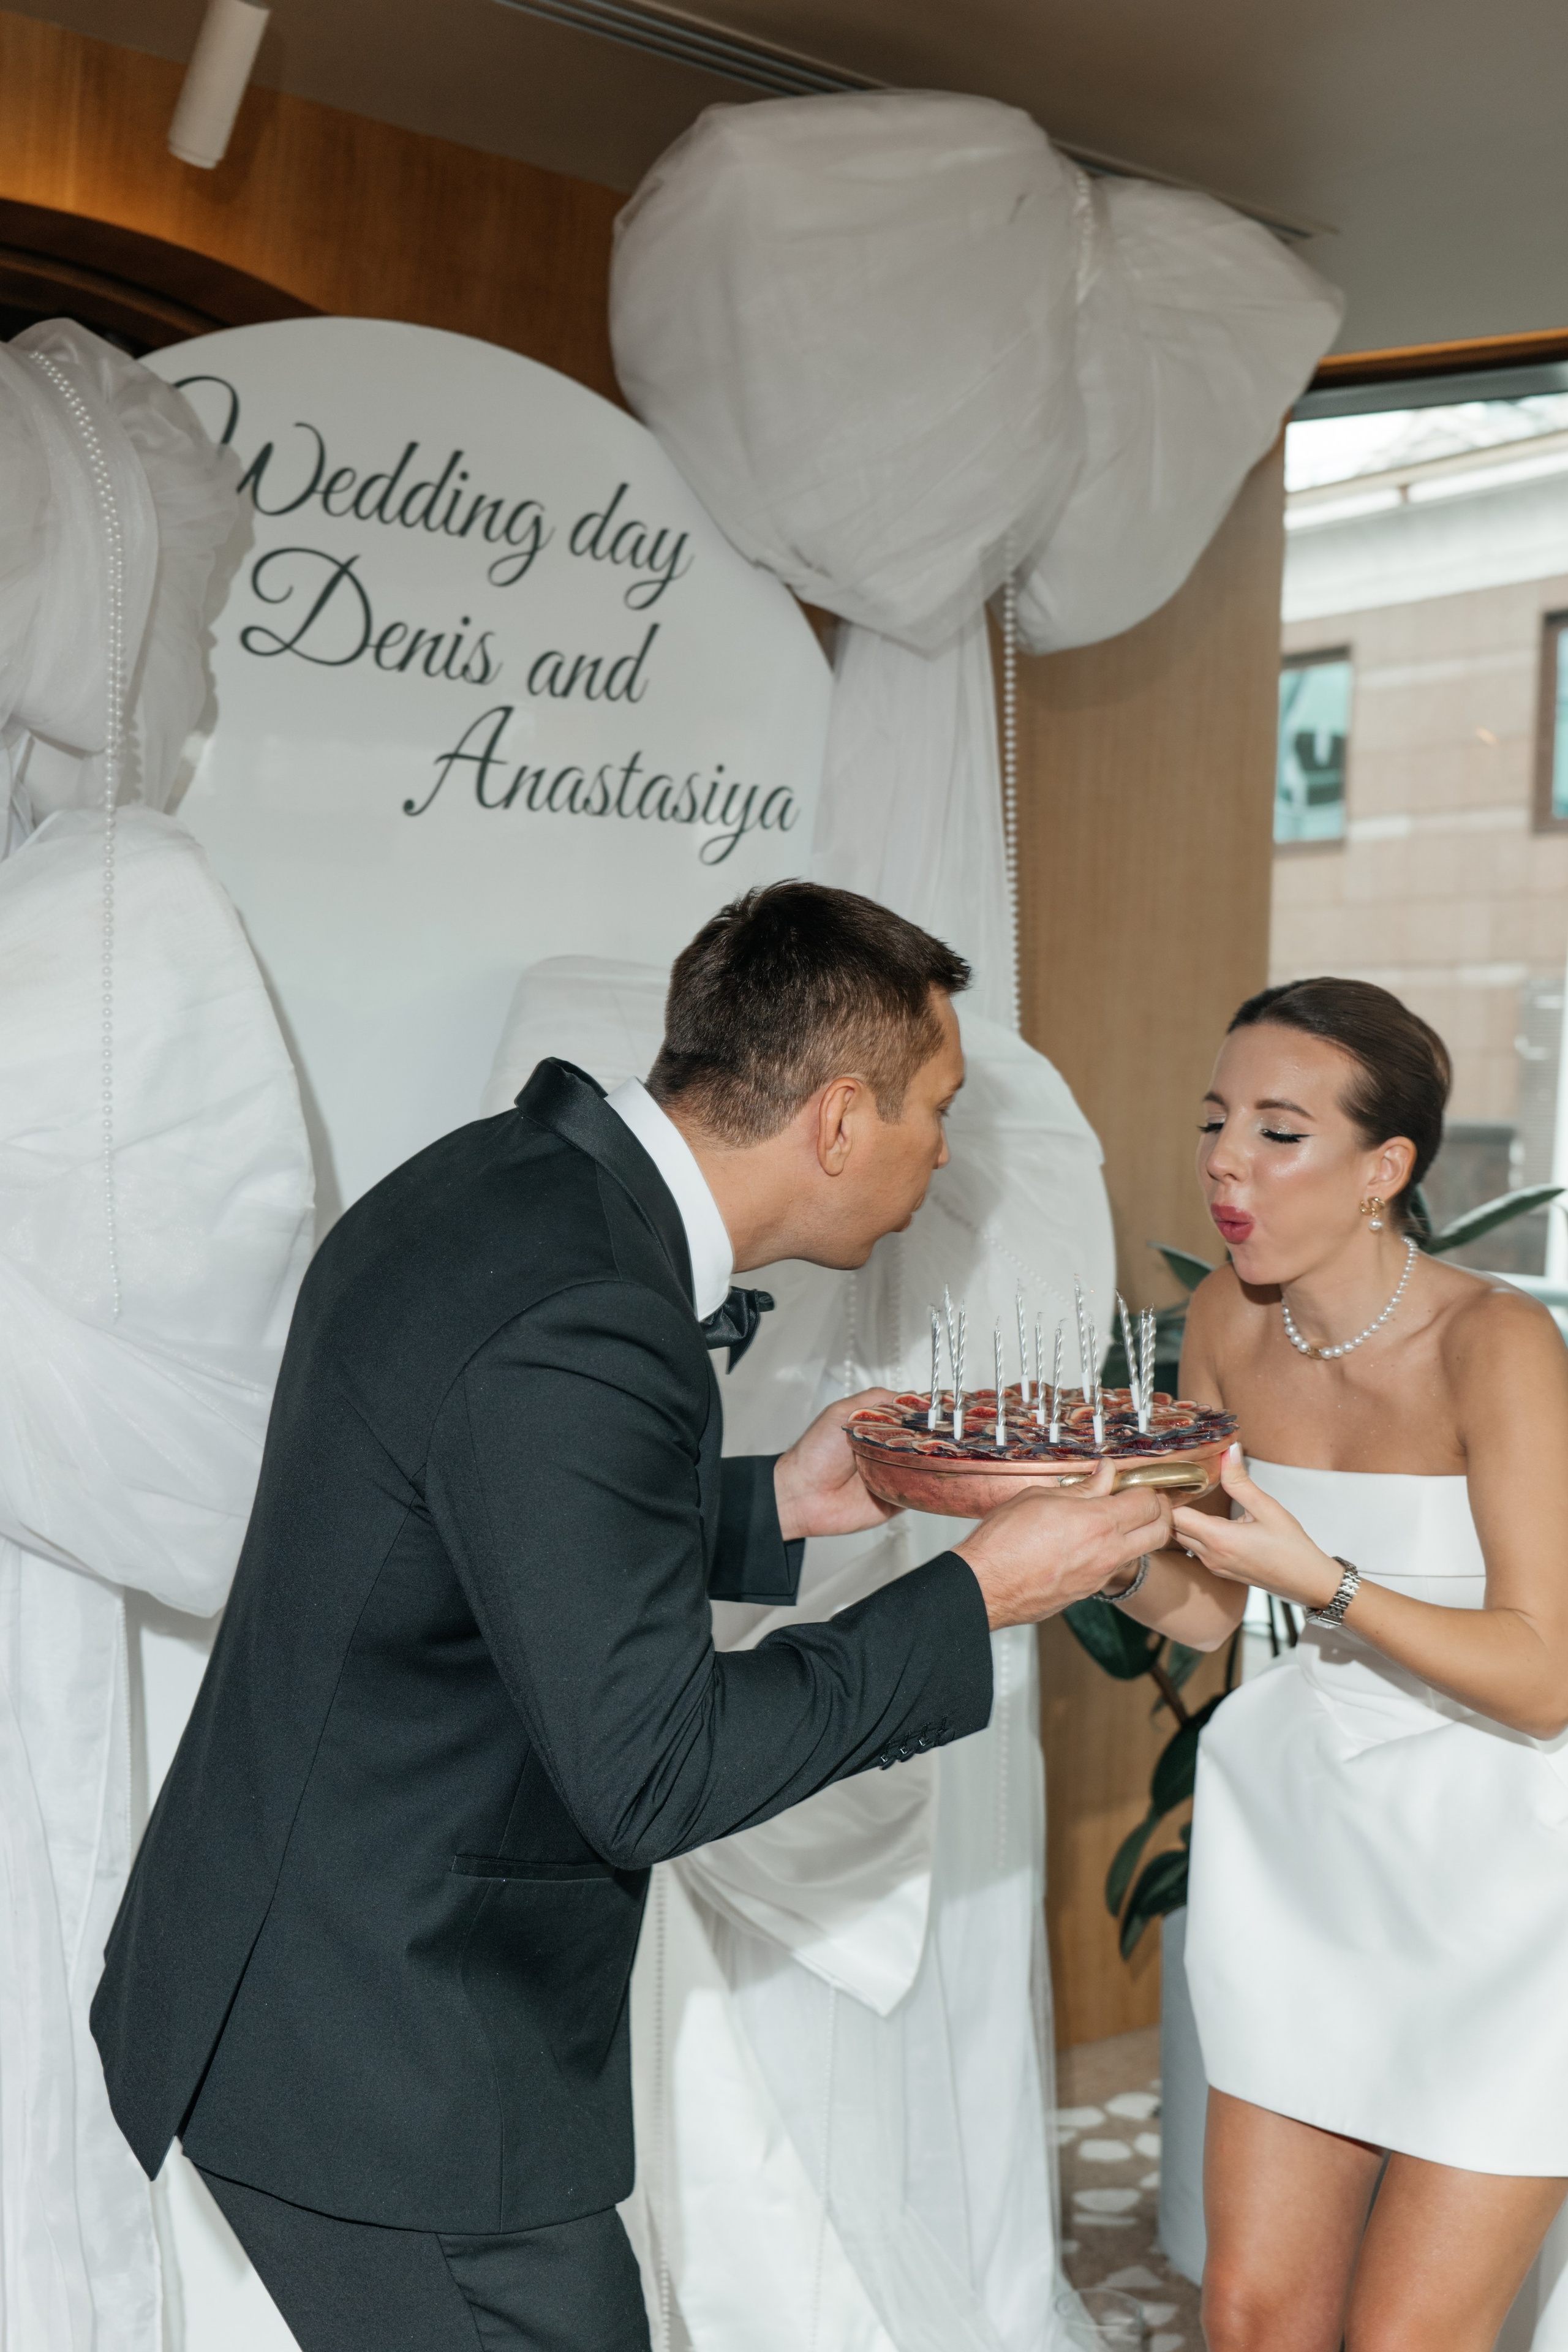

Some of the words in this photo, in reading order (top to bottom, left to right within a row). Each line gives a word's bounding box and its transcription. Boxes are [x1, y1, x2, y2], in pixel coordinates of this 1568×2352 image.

[170, 375, 554, 587] Wedding
[569, 482, 695, 611] day
[239, 546, 502, 686] Denis
[526, 622, 660, 704] and
[402, 705, 800, 866] Anastasiya
